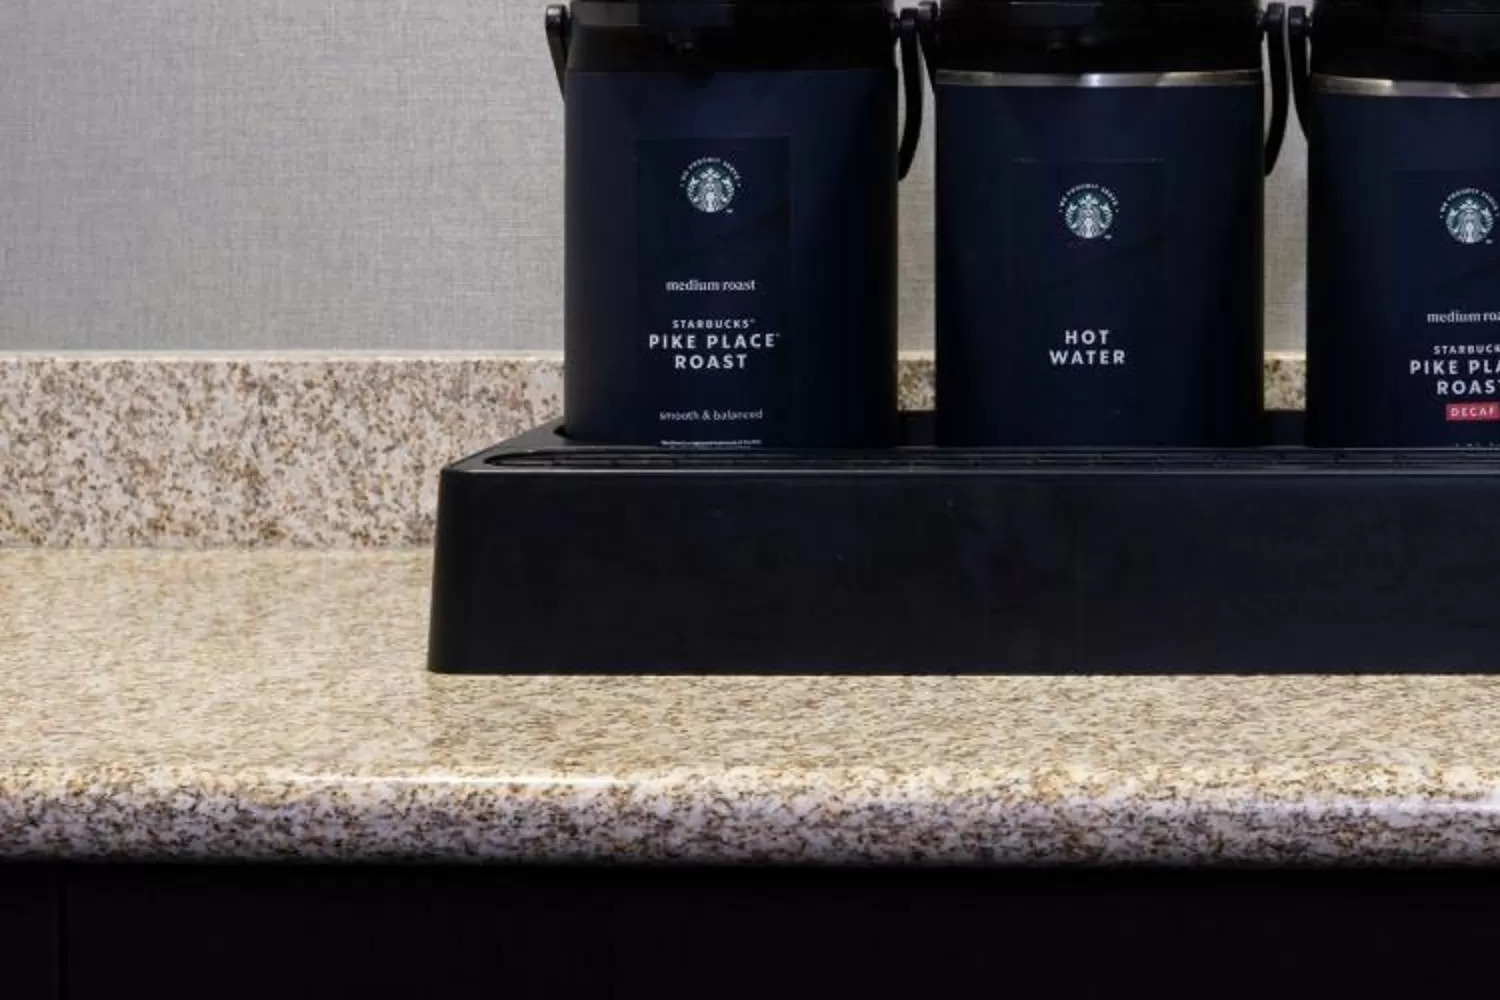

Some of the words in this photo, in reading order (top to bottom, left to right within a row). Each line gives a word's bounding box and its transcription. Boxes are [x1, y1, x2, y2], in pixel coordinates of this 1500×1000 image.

[666, 279, 720, 291] medium
[723, 279, 756, 291] roast
[1427, 309, 1481, 323] medium
[672, 319, 750, 329] STARBUCKS
[649, 334, 697, 349] PIKE
[707, 333, 776, 349] PLACE
[1064, 329, 1110, 344] HOT
[674, 354, 748, 369] ROAST
[1049, 349, 1126, 365] WATER
[1409, 359, 1459, 375] PIKE
[1450, 405, 1496, 417] DECAF
